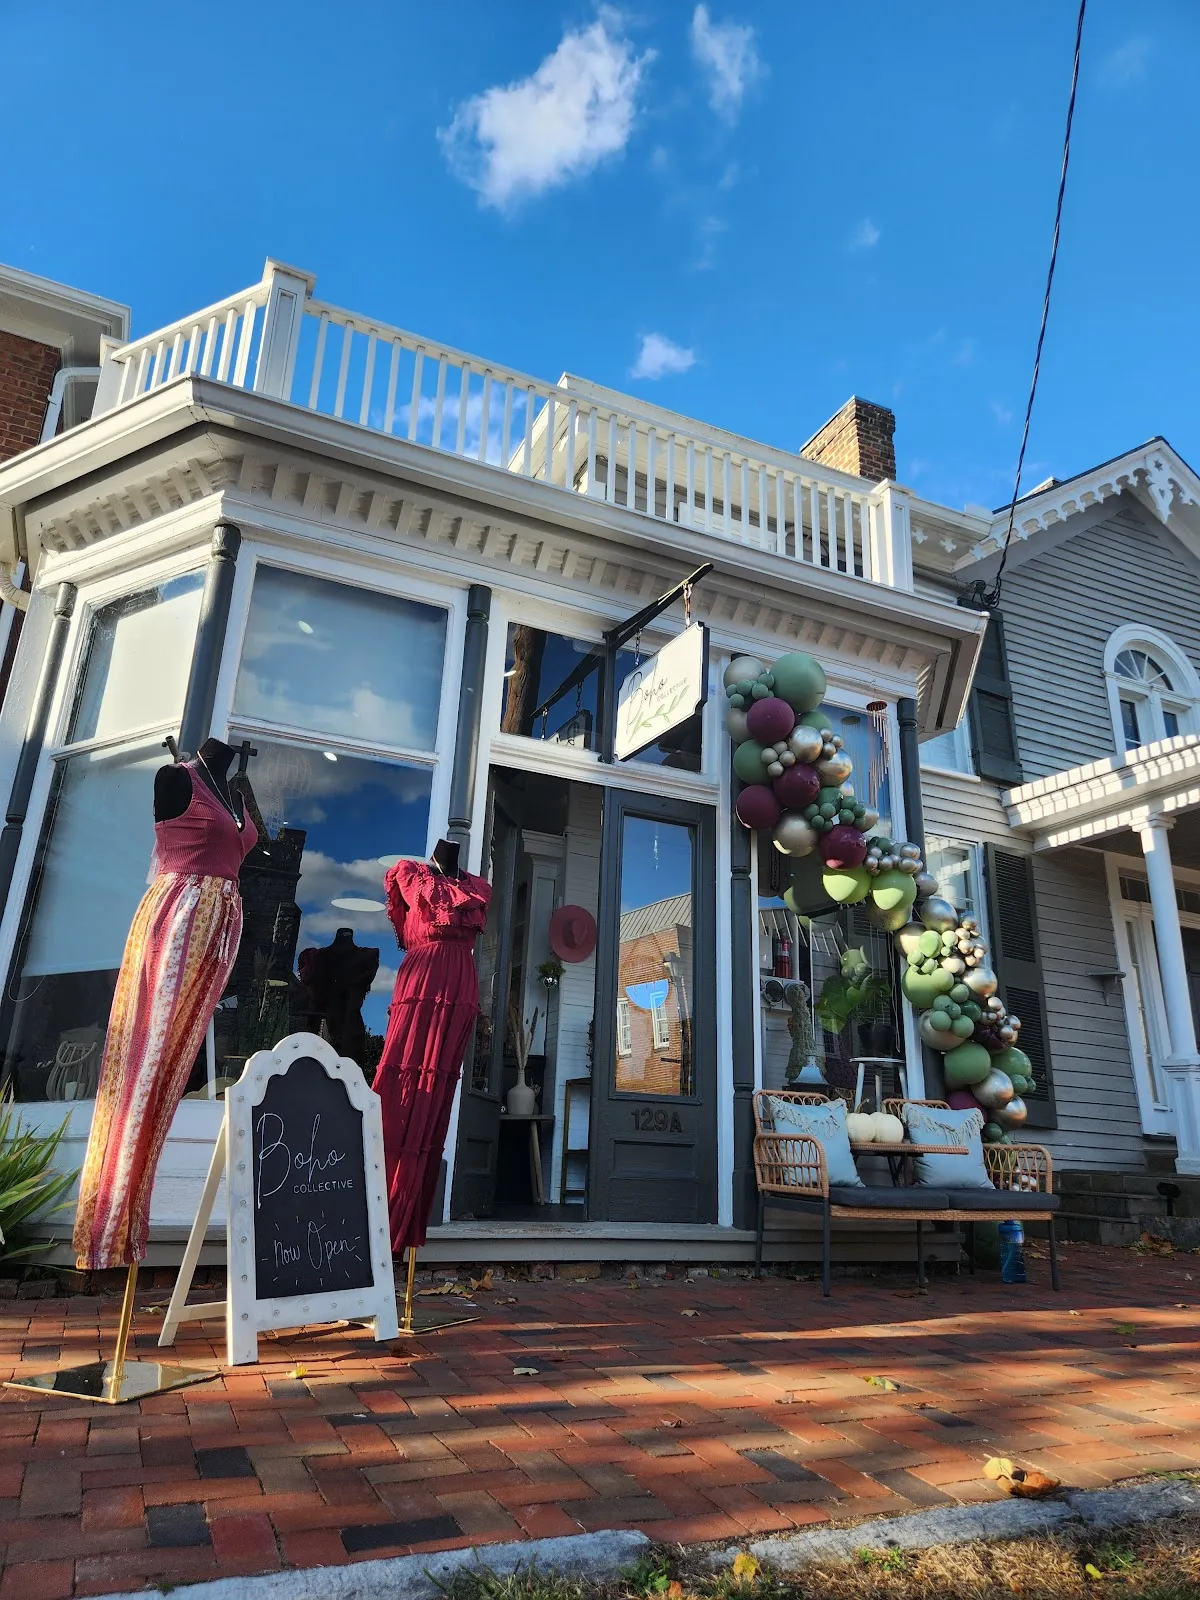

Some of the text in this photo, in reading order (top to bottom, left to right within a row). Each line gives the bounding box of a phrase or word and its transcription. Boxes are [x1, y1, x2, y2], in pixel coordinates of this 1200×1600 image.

[626, 657, 668, 736] Boho
[656, 677, 688, 702] COLLECTIVE
[631, 1107, 682, 1133] 129A
[256, 1112, 346, 1209] Boho
[293, 1179, 354, 1194] COLLECTIVE
[307, 1220, 357, 1272] Open
